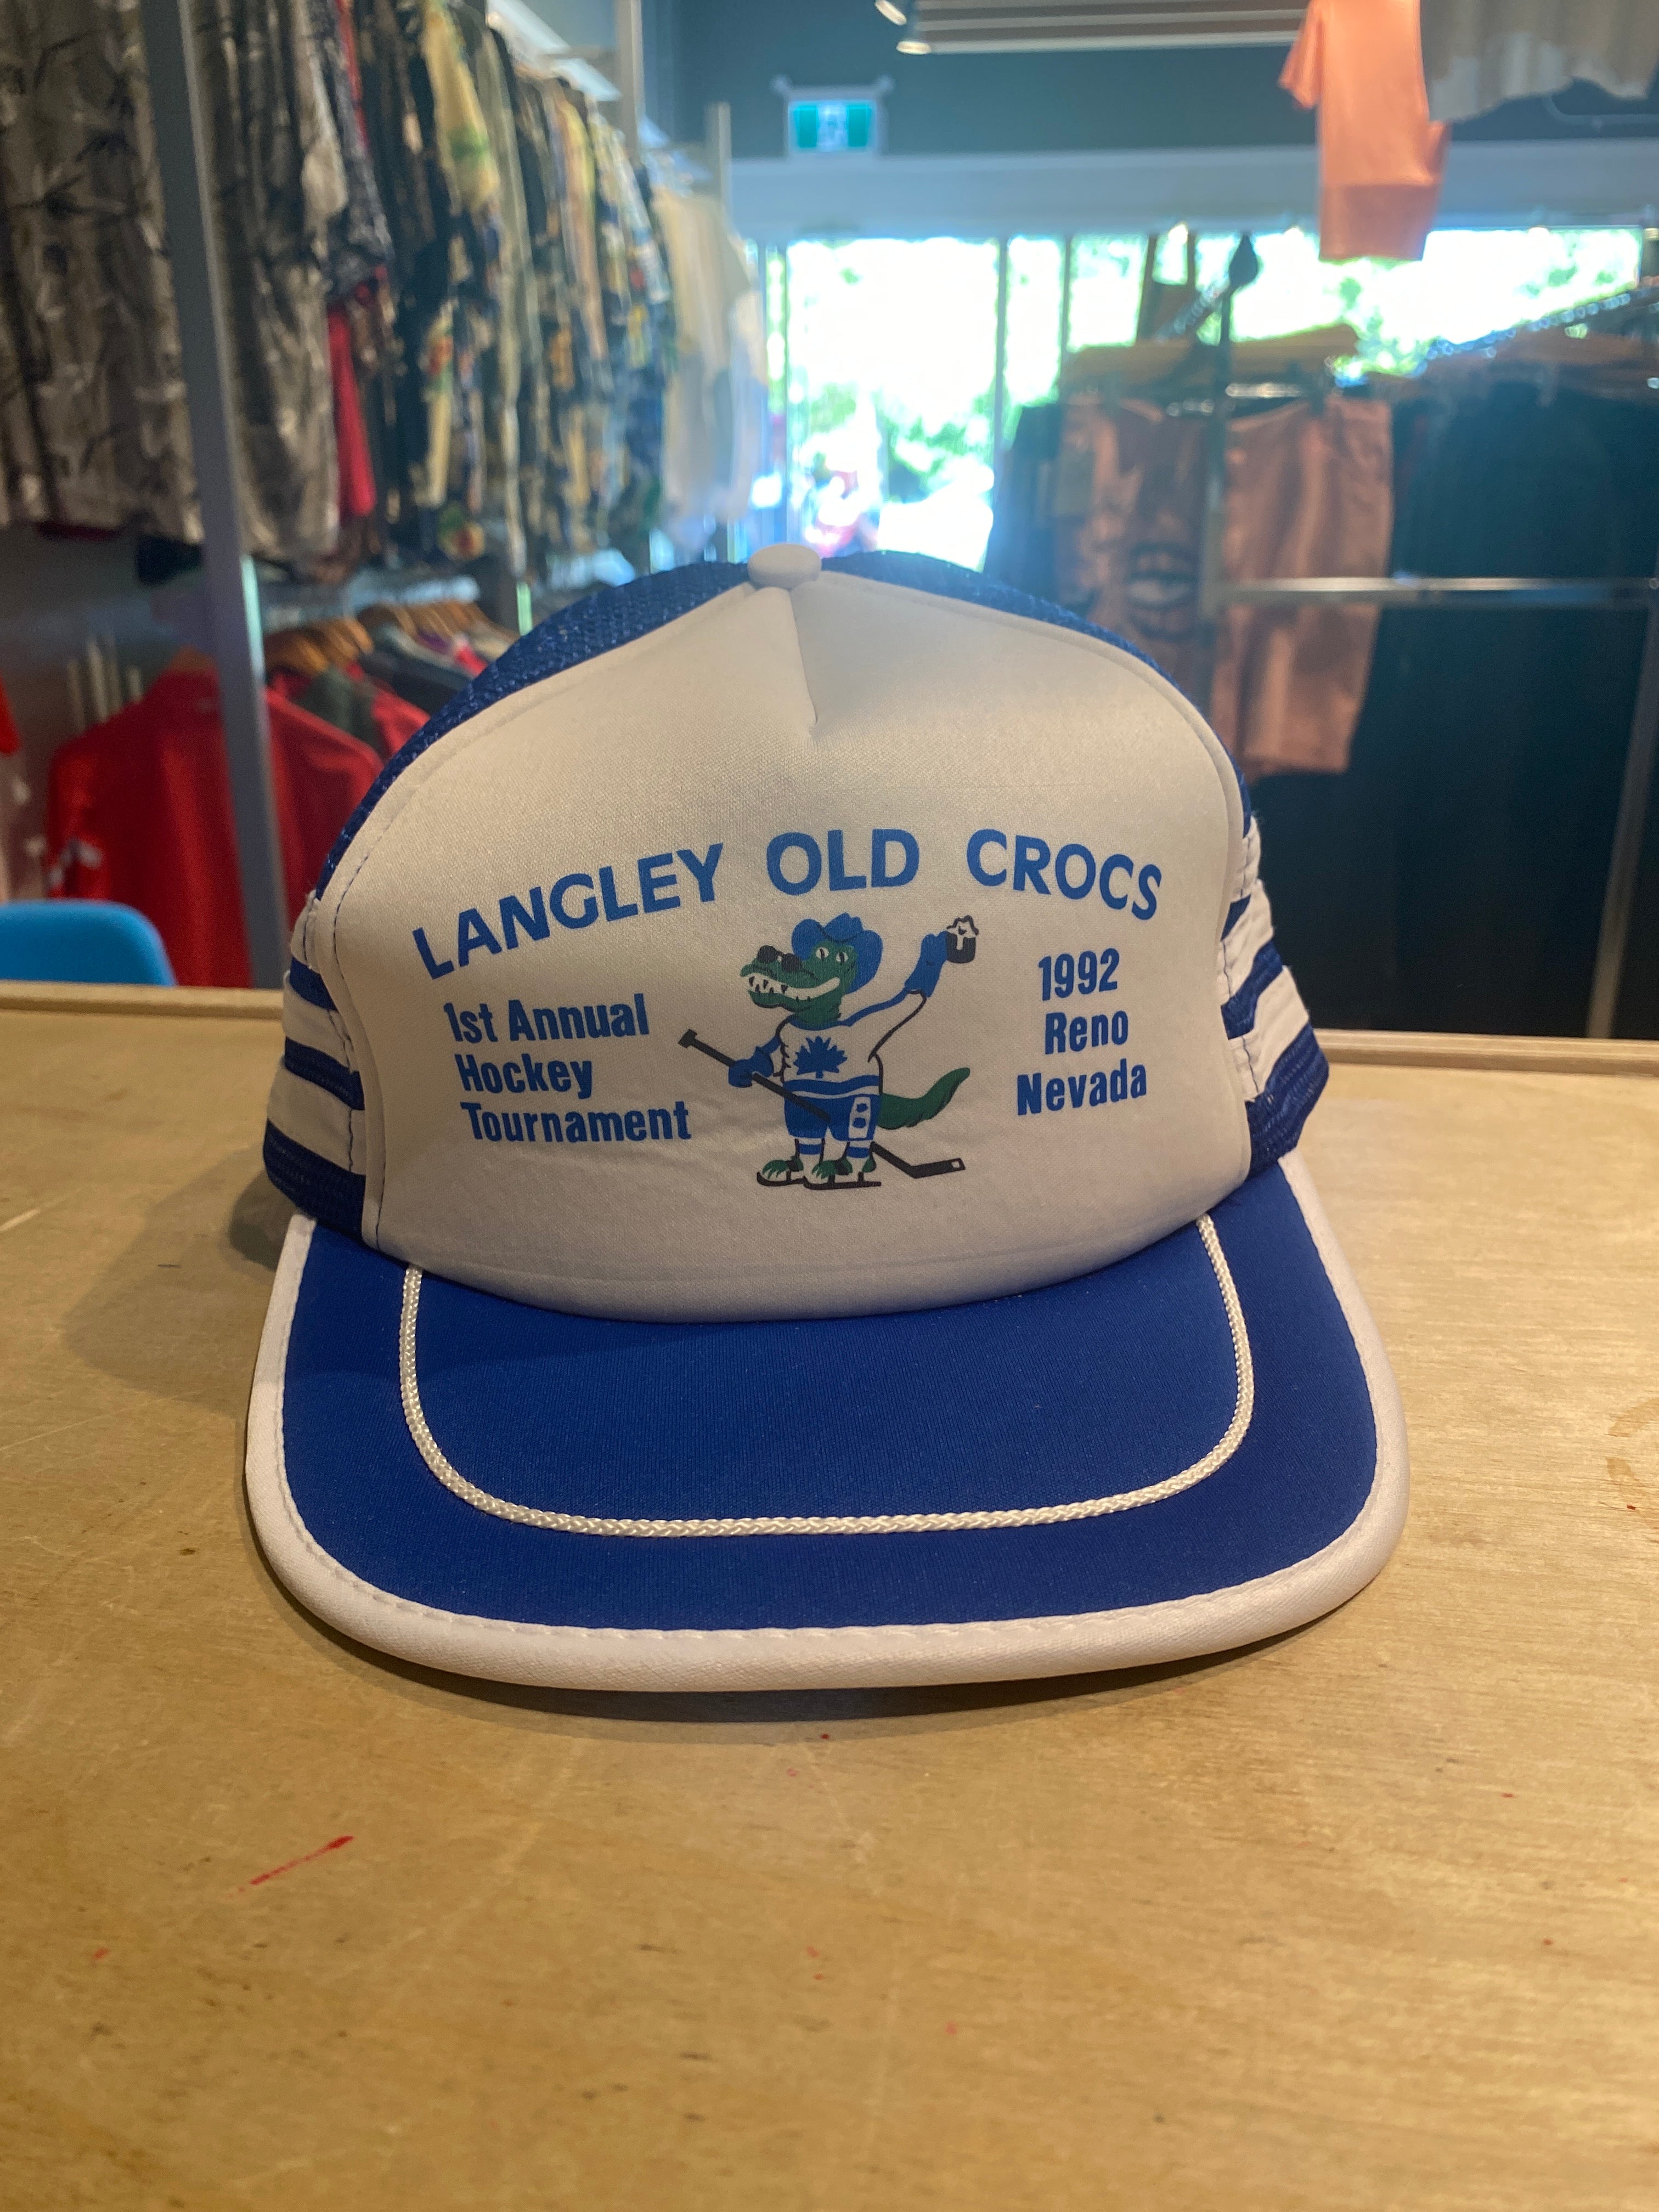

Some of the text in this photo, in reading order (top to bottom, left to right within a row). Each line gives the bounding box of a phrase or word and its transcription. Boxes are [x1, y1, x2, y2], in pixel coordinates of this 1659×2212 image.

[413, 828, 1162, 979] LANGLEY OLD CROCS
[1038, 947, 1119, 1001] 1992
[443, 994, 649, 1045] 1st Annual
[1045, 1011, 1128, 1054] Reno
[454, 1054, 593, 1099] Hockey
[1017, 1059, 1147, 1116] Nevada
[460, 1102, 690, 1144] Tournament
